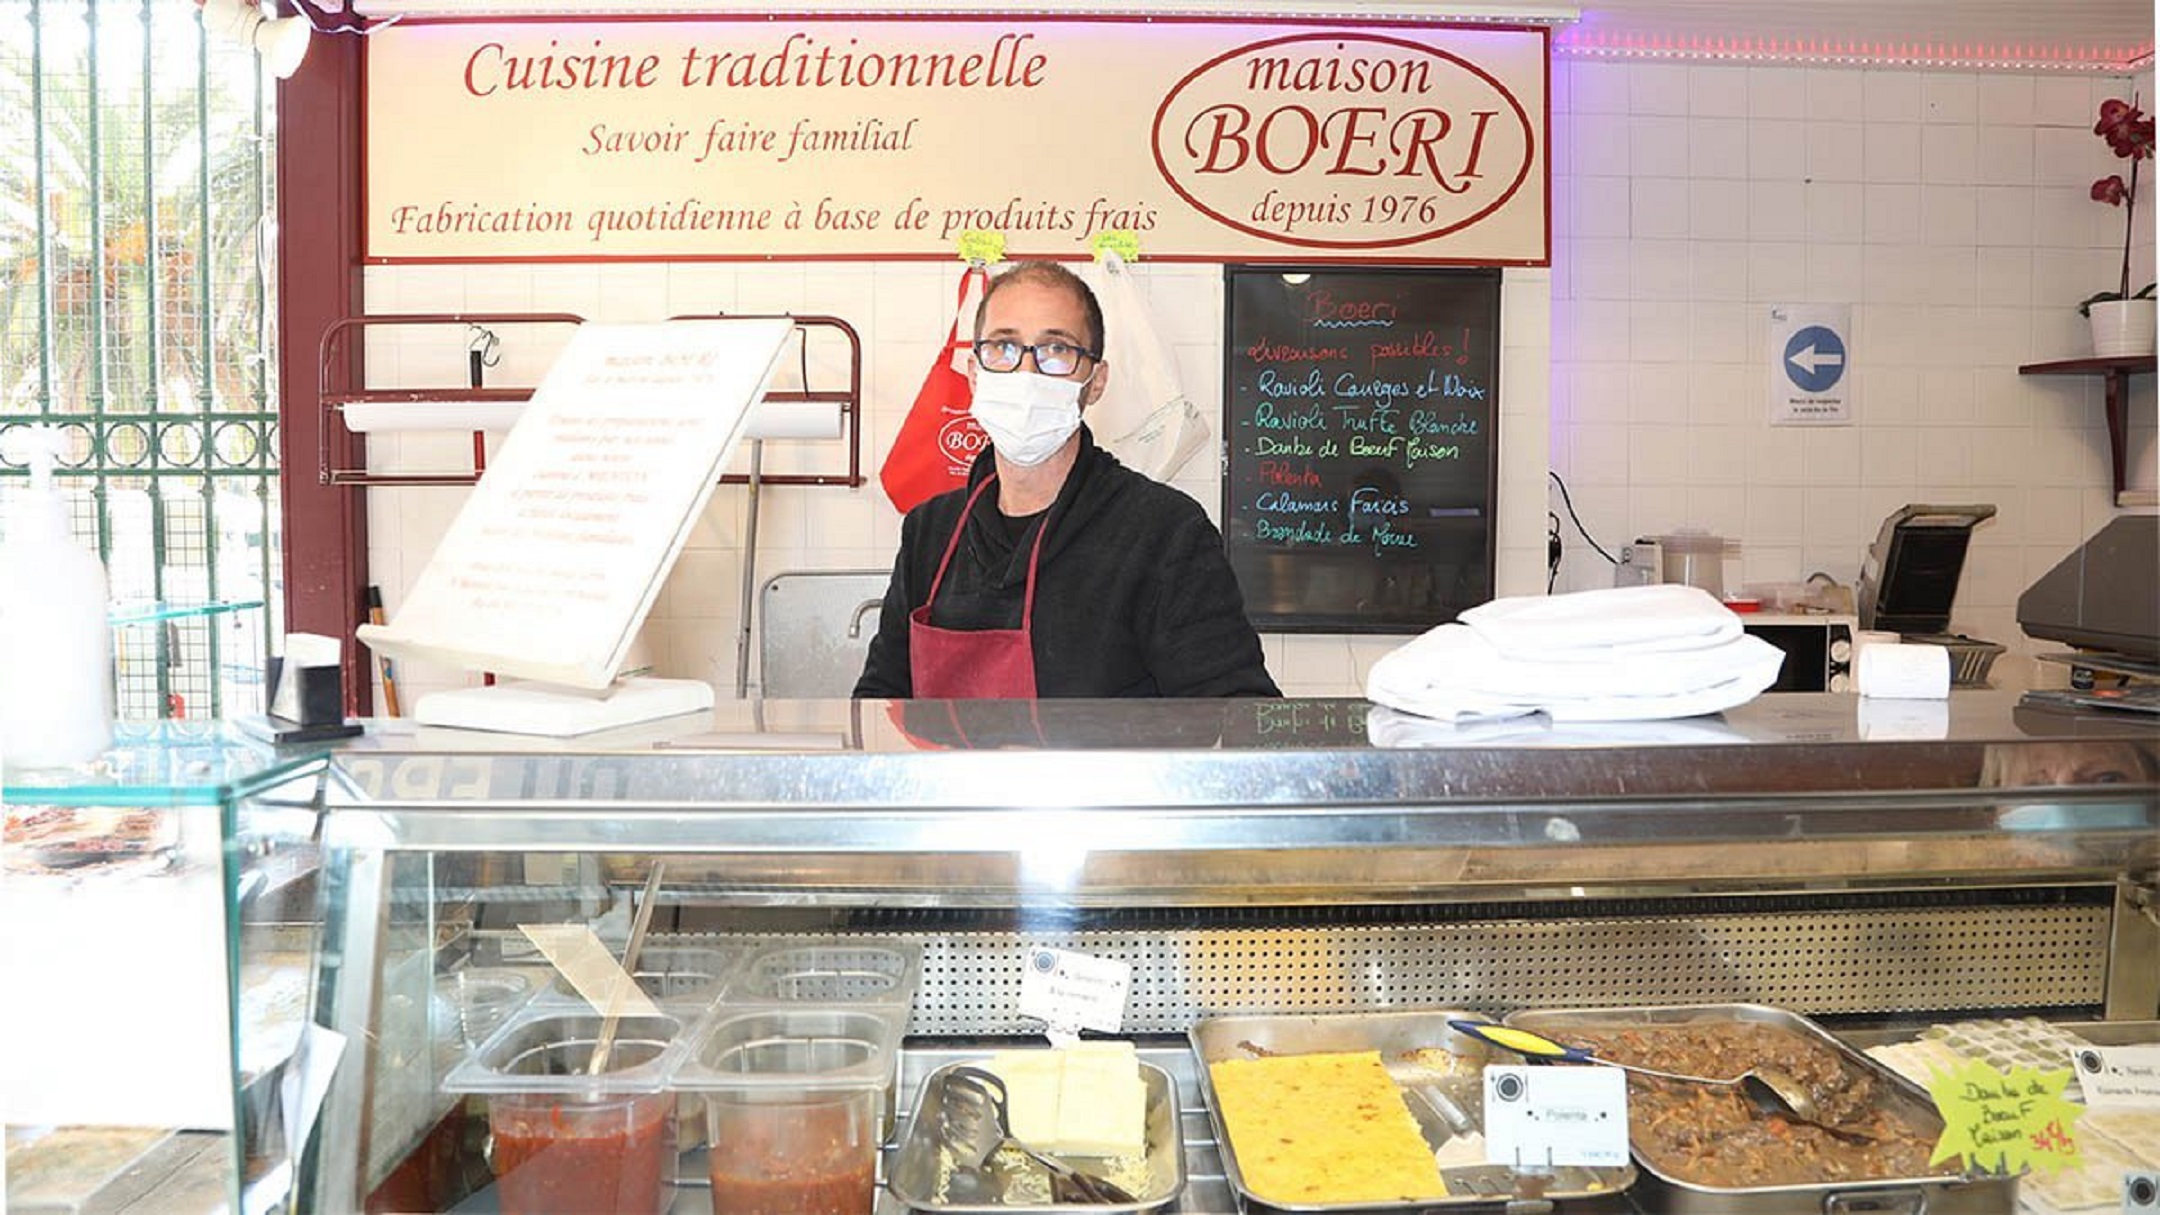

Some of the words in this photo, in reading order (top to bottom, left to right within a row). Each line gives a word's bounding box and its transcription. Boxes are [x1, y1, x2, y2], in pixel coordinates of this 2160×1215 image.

[464, 40, 660, 97] Cuisine
[681, 32, 1047, 88] traditionnelle
[1246, 42, 1433, 94] maison
[581, 121, 689, 157] Savoir
[694, 119, 778, 163] faire
[778, 117, 920, 163] familial
[1185, 103, 1499, 194] BOERI
[391, 202, 573, 235] Fabrication
[587, 199, 772, 241] quotidienne
[783, 202, 801, 232] à
[814, 198, 882, 233] base
[893, 198, 929, 233] de
[940, 198, 1075, 242] produits
[1075, 197, 1158, 241] frais
[1250, 189, 1351, 233] depuis
[1363, 194, 1437, 225] 1976
[1303, 291, 1398, 320] Boeri
[1258, 369, 1326, 398] Ravioli
[1255, 402, 1327, 432] Ravioli
[1409, 409, 1478, 435] Blanche
[1319, 439, 1340, 458] de
[1259, 460, 1322, 486] Polenta
[1340, 525, 1363, 544] de
[2028, 1080, 2048, 1095] de
